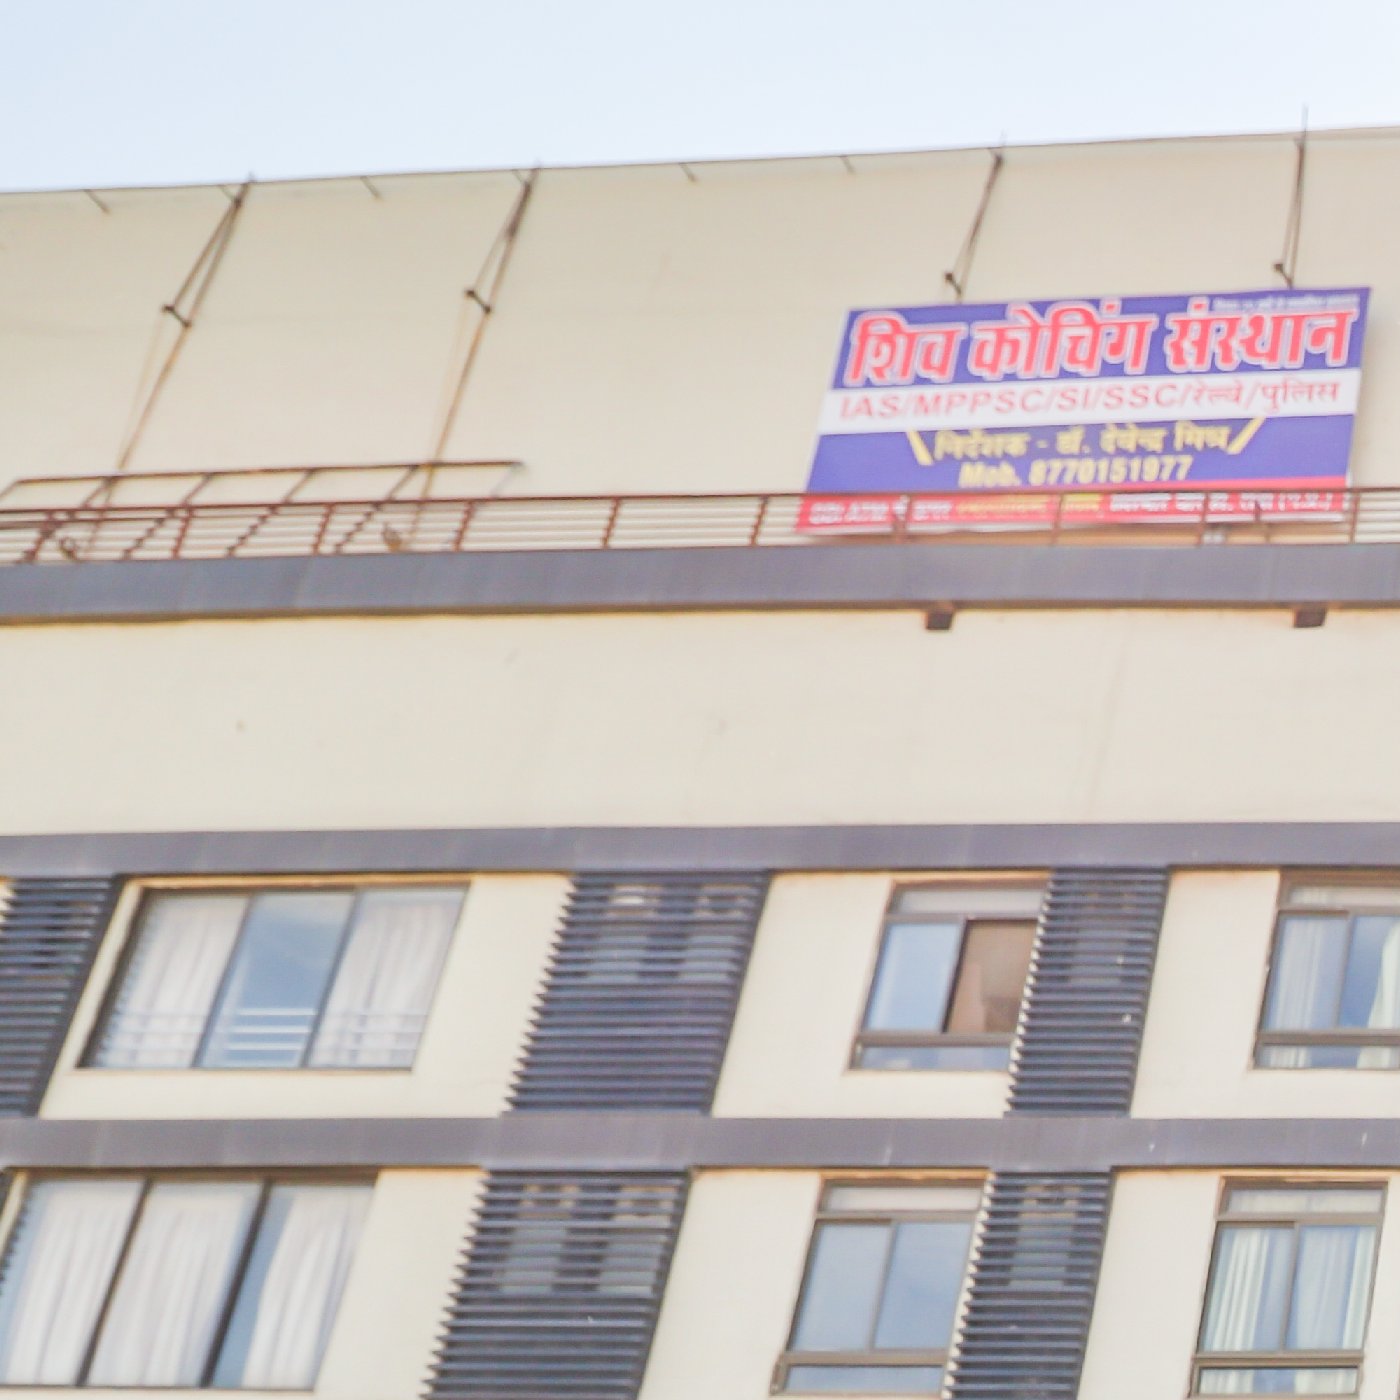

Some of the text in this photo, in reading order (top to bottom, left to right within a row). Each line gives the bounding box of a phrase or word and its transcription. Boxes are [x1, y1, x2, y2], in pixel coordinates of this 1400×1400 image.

[847, 298, 1356, 384] शिव कोचिंग संस्थान
